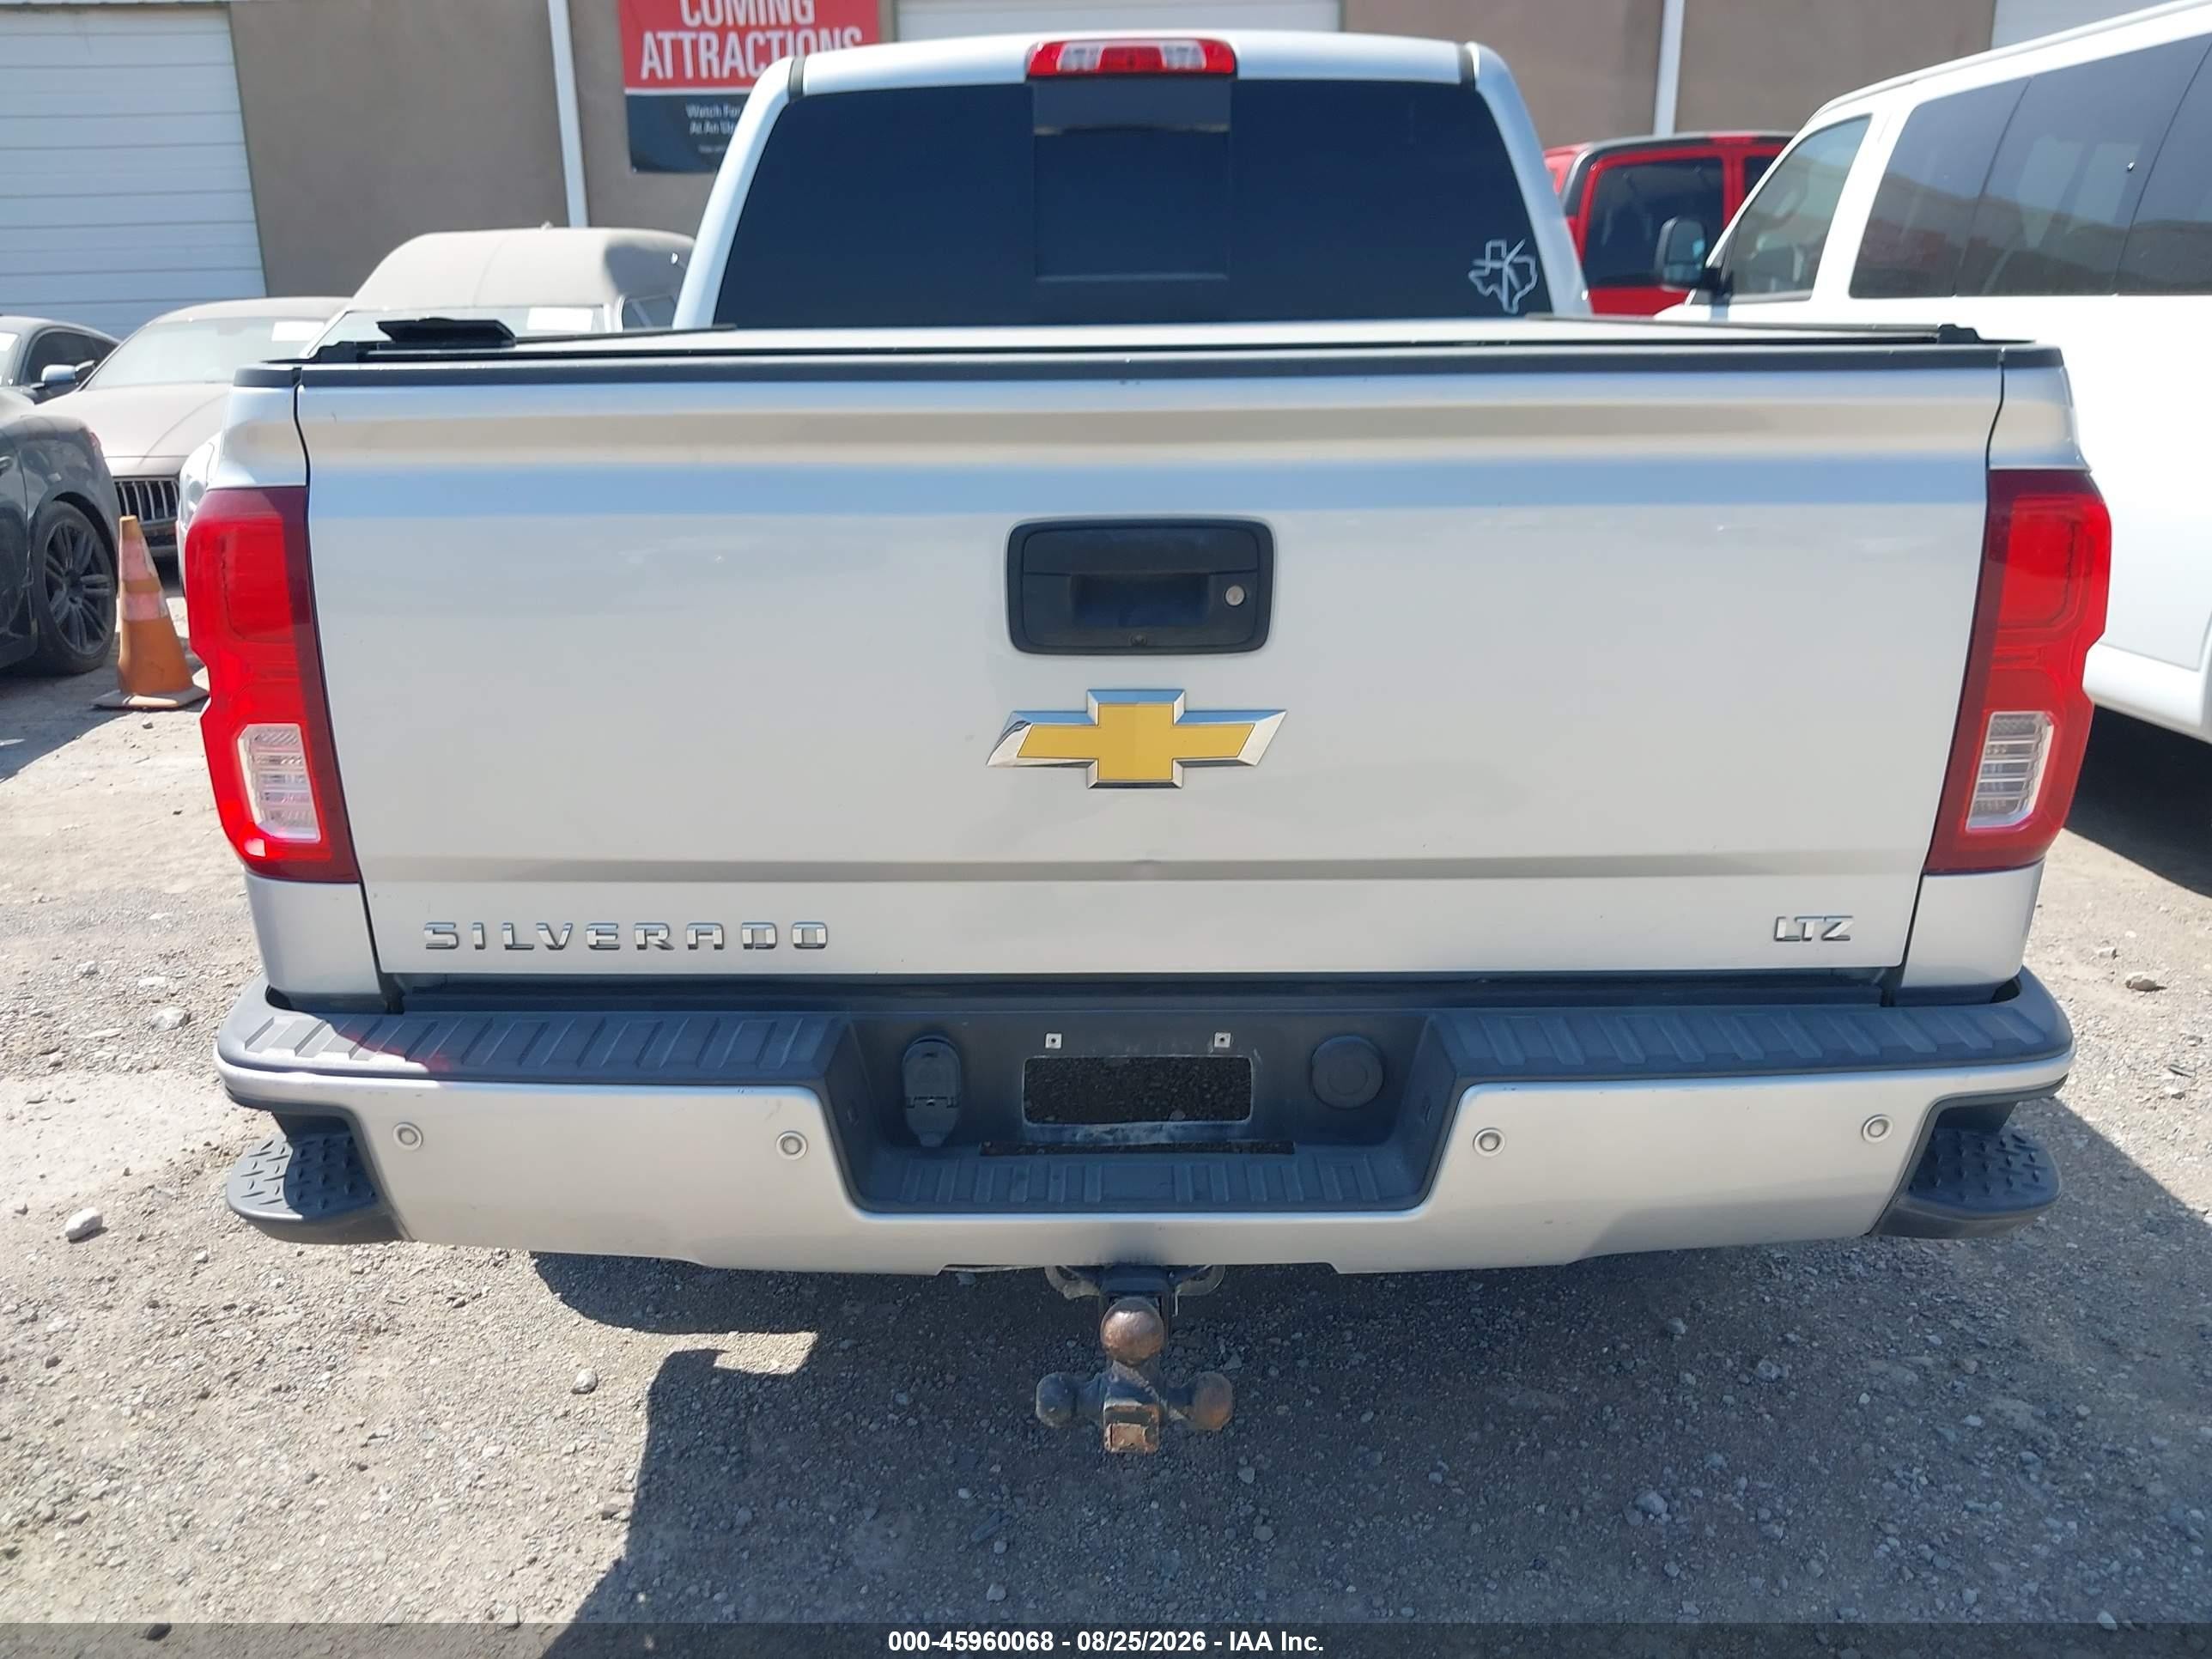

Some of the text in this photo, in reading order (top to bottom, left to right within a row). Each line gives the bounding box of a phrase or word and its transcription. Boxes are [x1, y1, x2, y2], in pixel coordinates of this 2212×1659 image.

[686, 104, 722, 118] Watch
[423, 921, 829, 951] SILVERADO
[1773, 916, 1854, 942] LTZ
